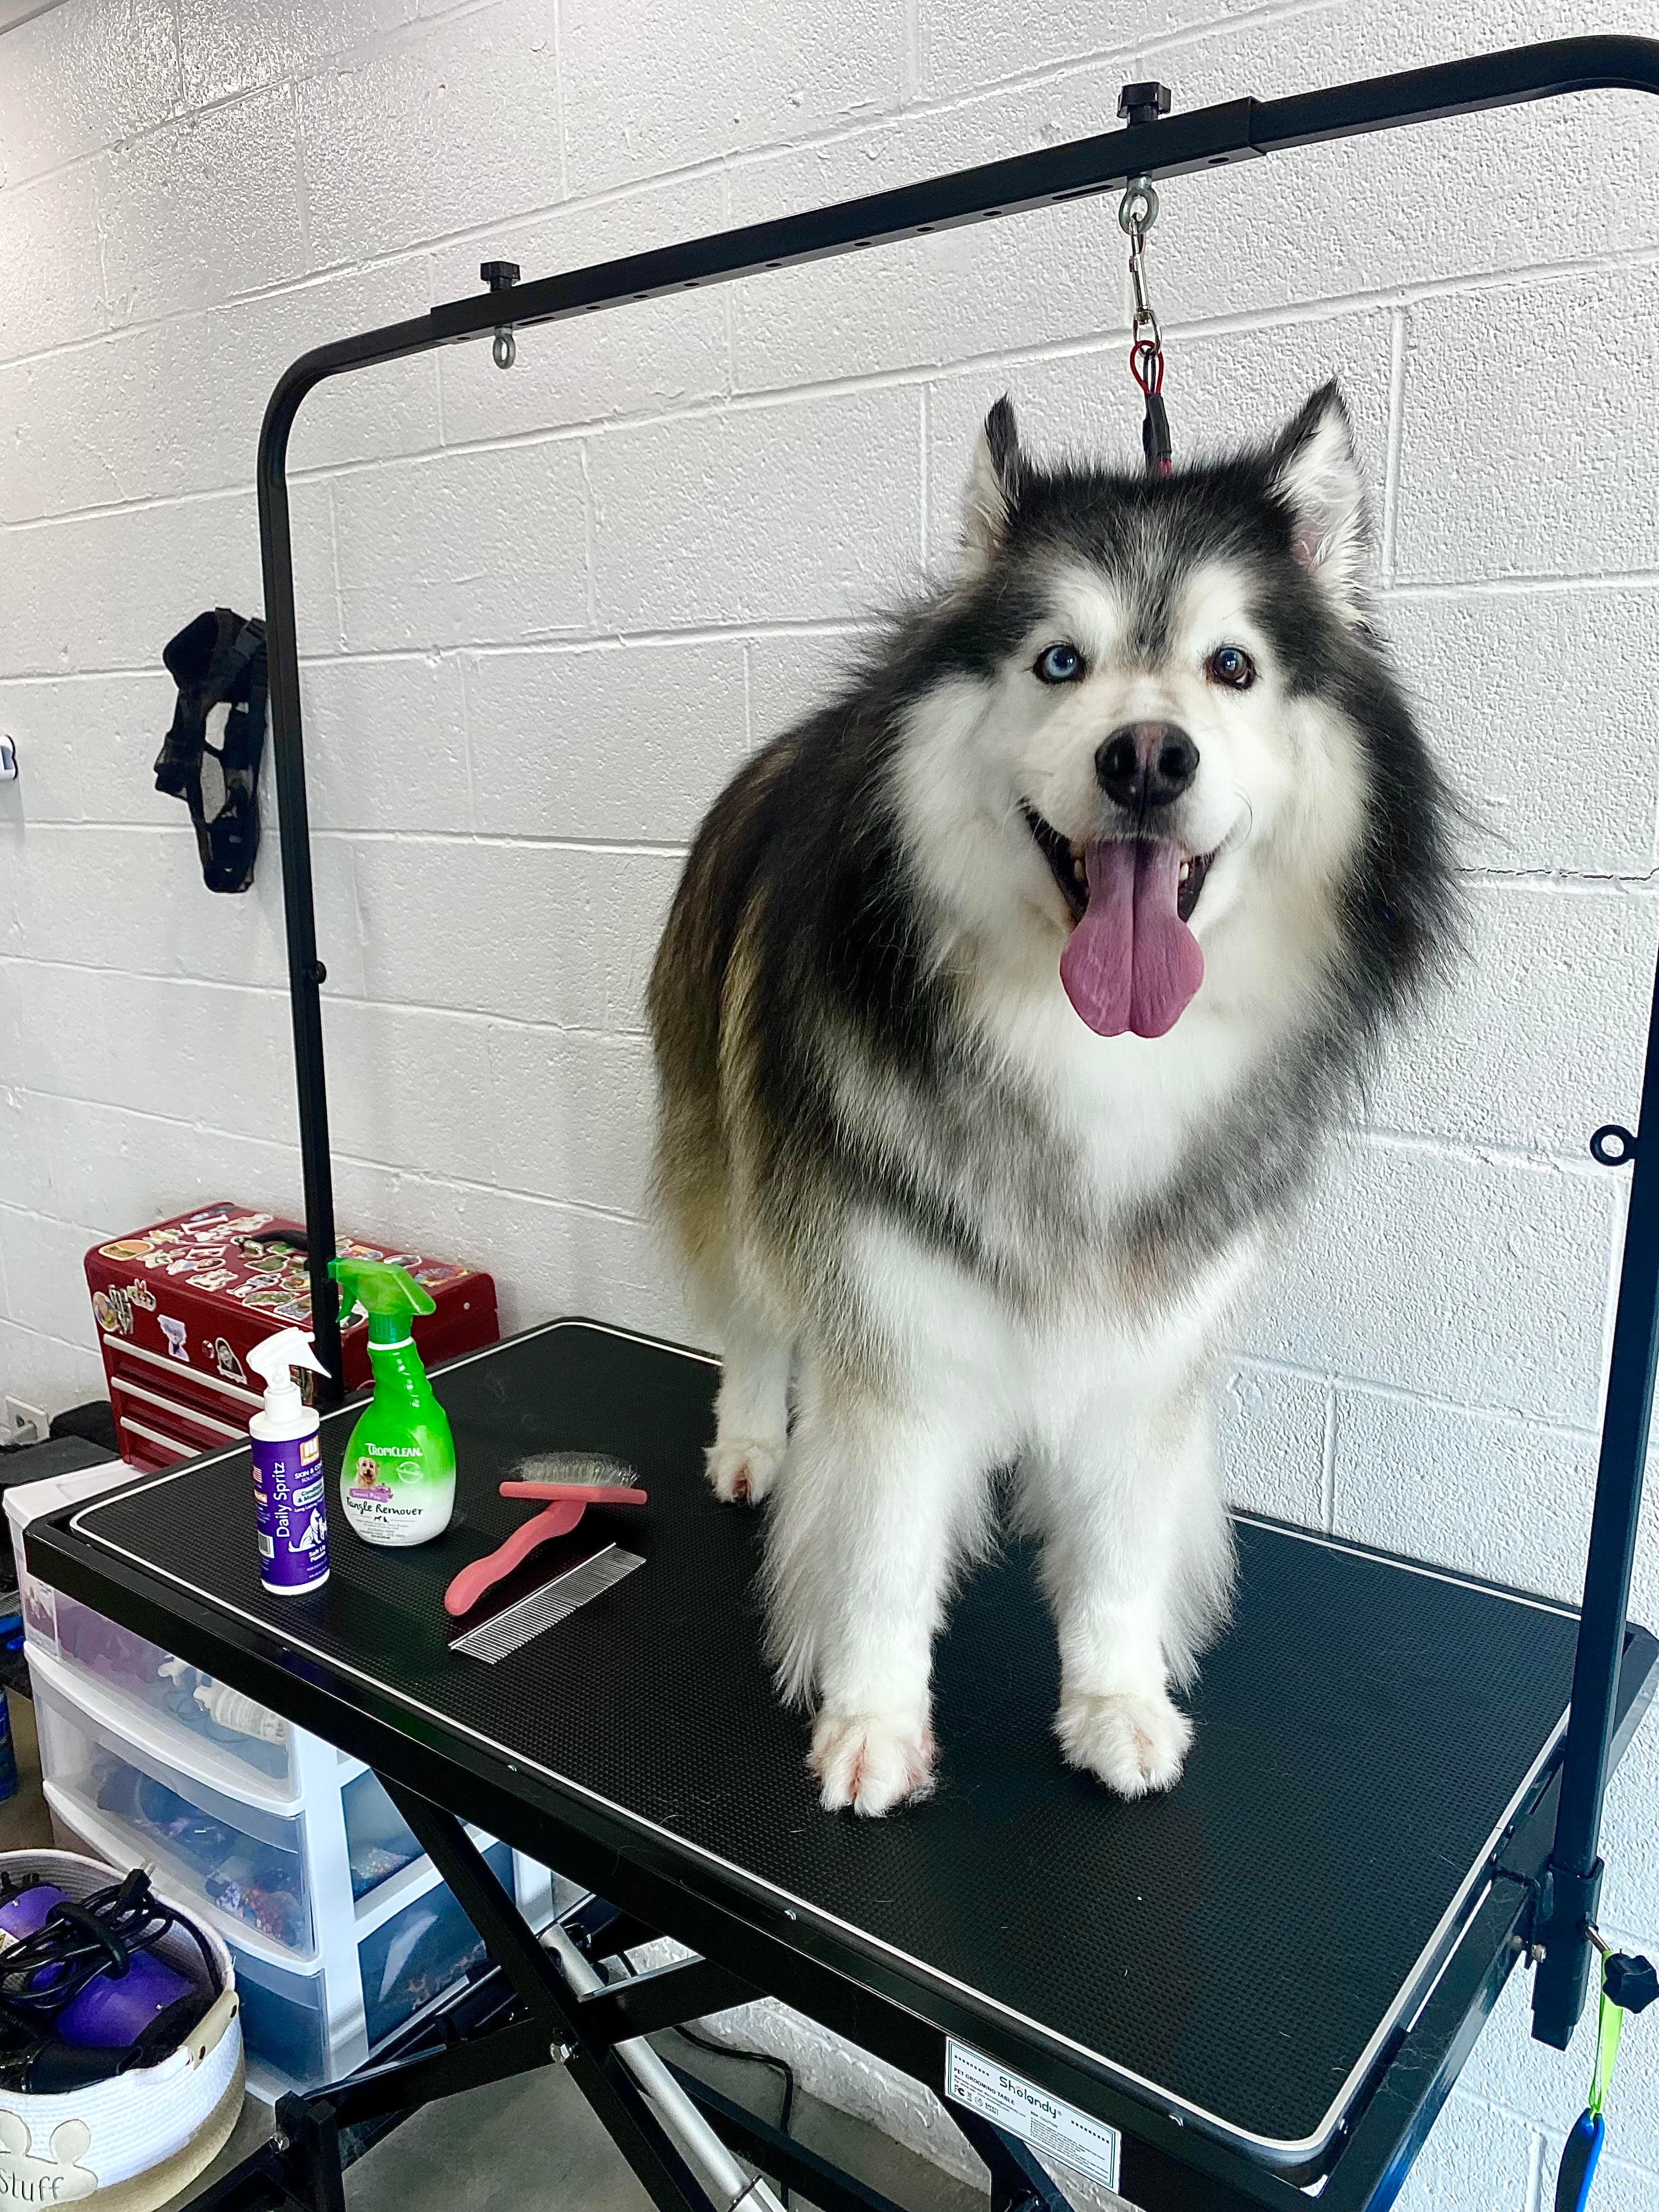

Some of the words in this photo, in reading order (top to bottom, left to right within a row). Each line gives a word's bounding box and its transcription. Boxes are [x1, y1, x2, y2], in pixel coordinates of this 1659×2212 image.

[272, 1462, 290, 1500] Spritz
[294, 1470, 309, 1479] SKIN
[274, 1504, 292, 1537] Daily
[346, 1496, 372, 1515] Tangle
[375, 1503, 423, 1515] Remover
[954, 2067, 964, 2076] PET
[965, 2074, 996, 2094] GROOMING
[997, 2091, 1015, 2106] TABLE
[999, 2076, 1057, 2119] Sholandy
[0, 2168, 64, 2202] Stuff
